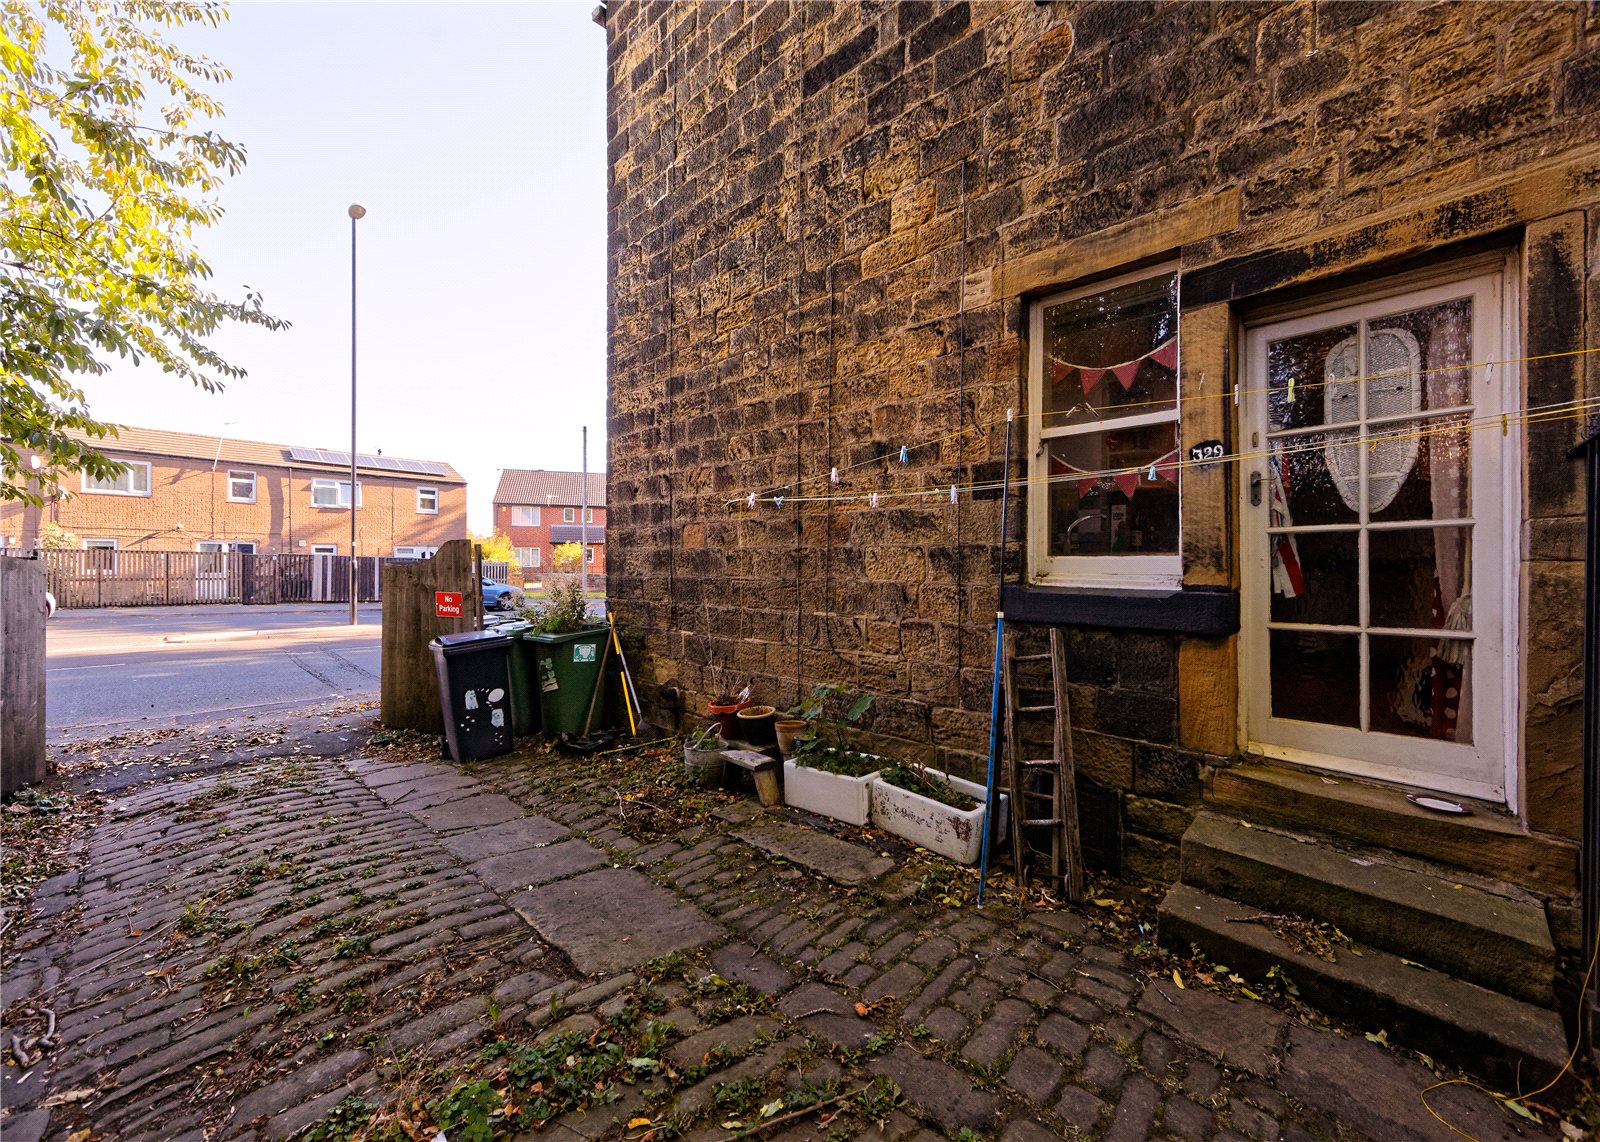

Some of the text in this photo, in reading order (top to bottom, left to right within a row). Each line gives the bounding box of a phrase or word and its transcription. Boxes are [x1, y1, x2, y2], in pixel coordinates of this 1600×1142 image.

[1192, 445, 1224, 462] 329
[444, 595, 453, 603] No
[438, 604, 460, 615] Parking
